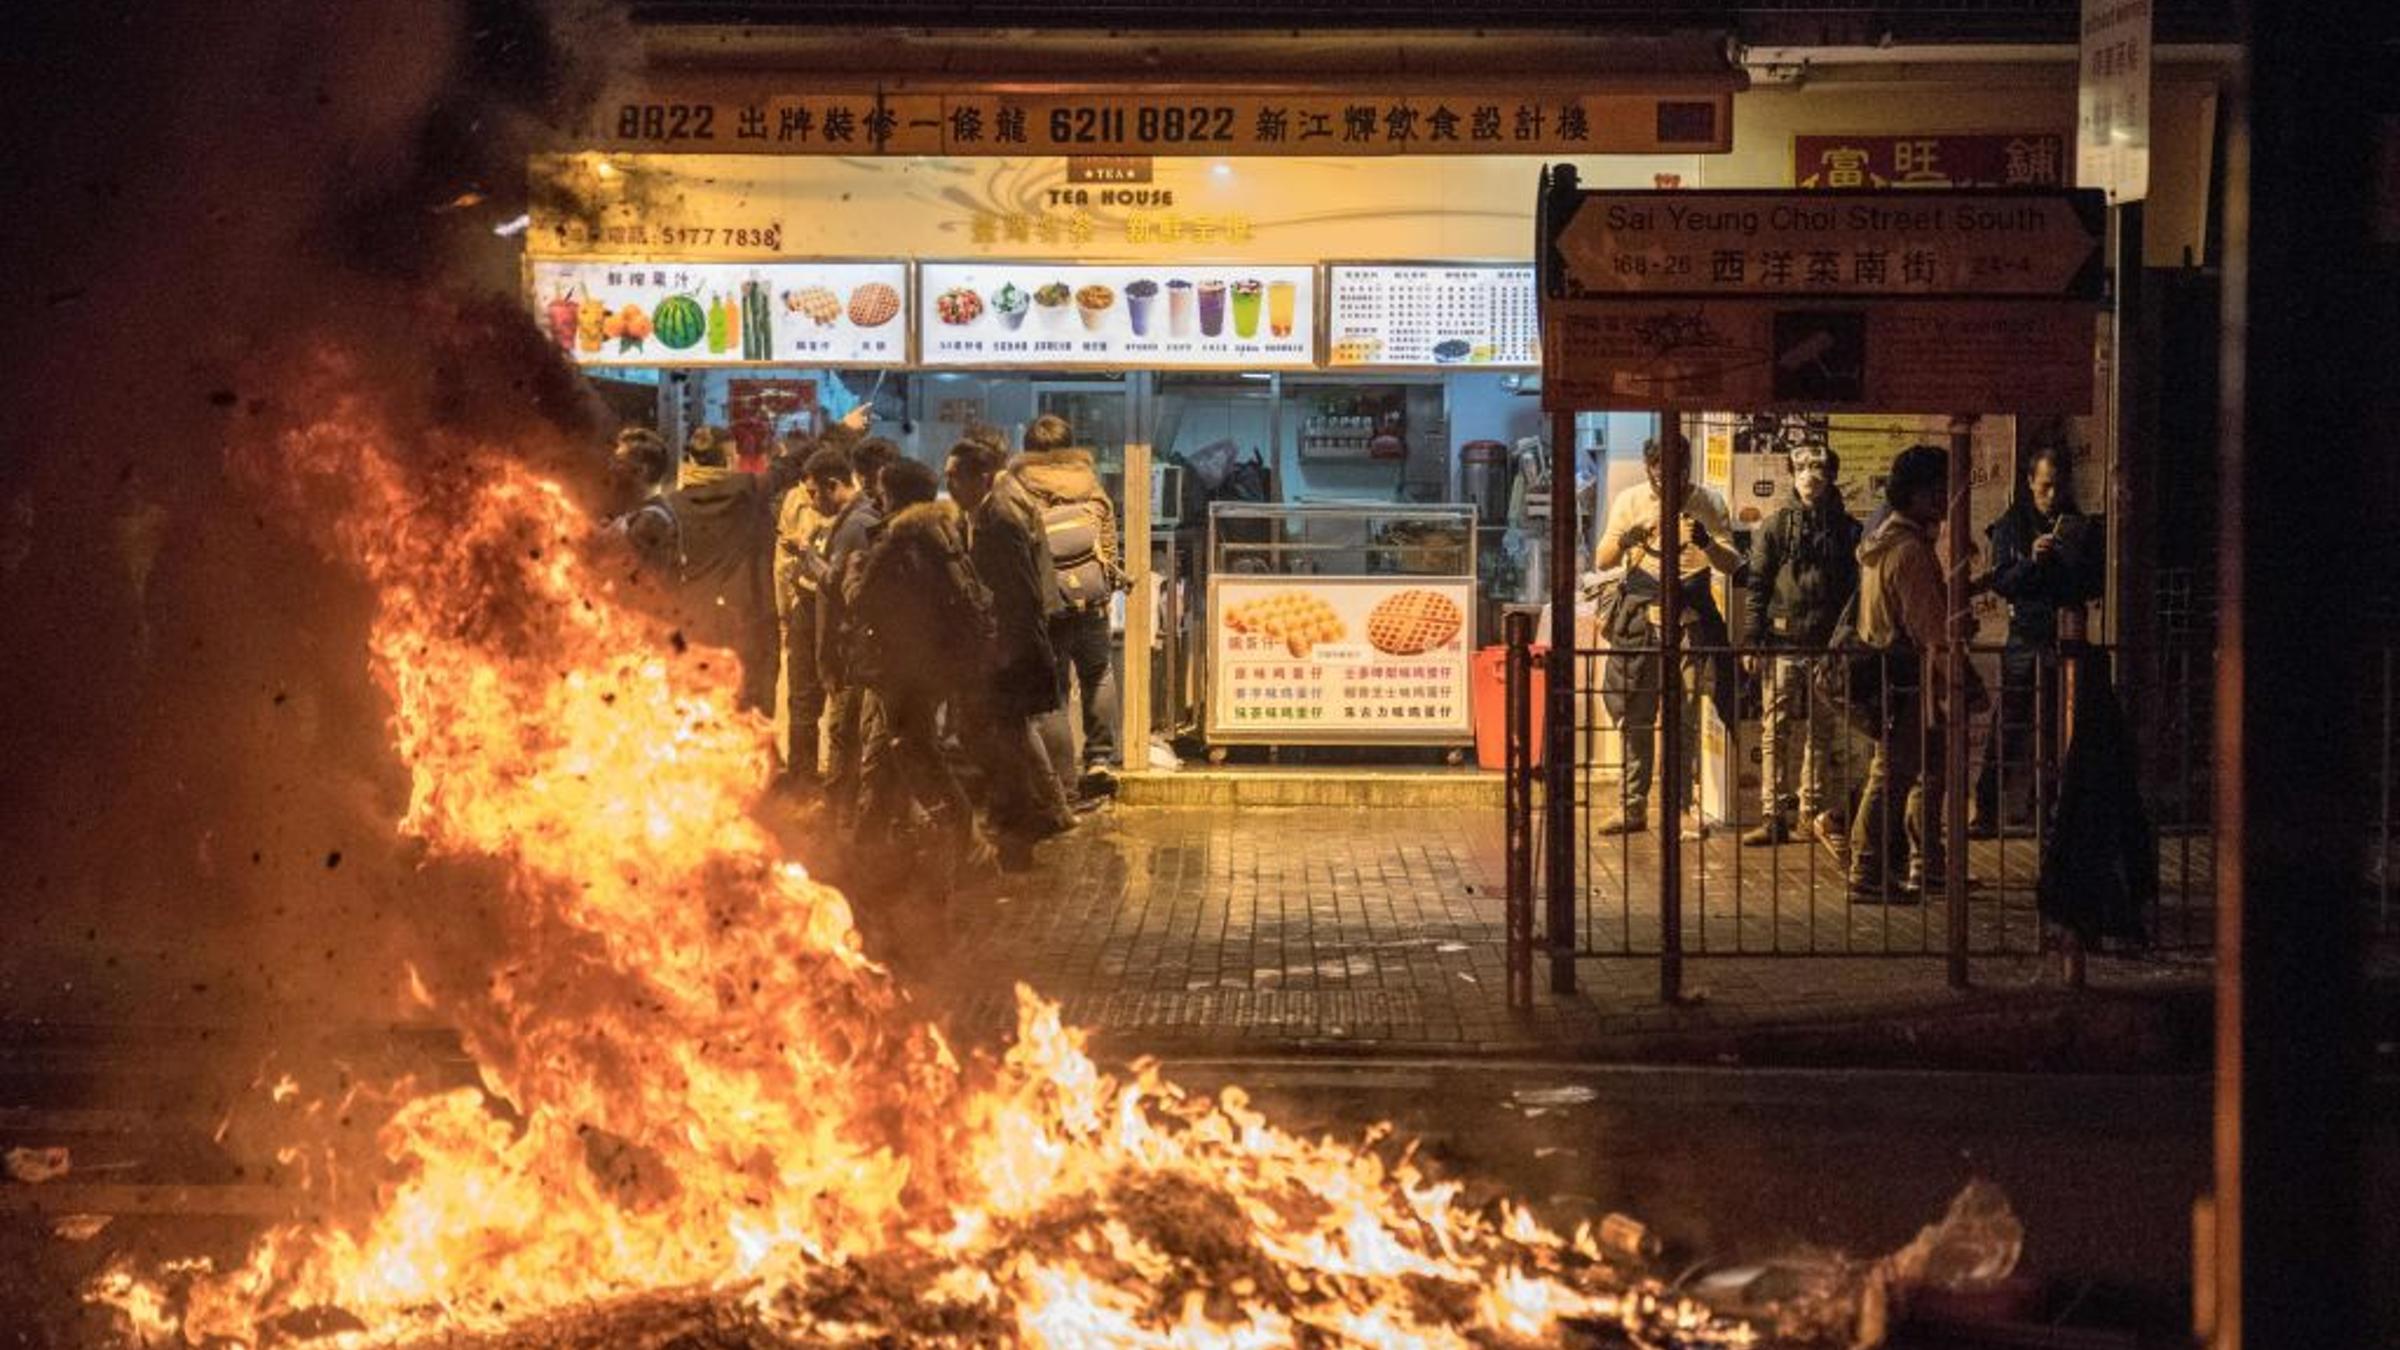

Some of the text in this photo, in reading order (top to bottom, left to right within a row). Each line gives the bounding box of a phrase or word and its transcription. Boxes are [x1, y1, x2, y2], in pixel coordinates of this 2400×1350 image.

[737, 104, 1028, 143] 出牌裝修一條龍
[1050, 107, 1123, 143] 6211
[1138, 107, 1235, 142] 8822
[1256, 104, 1590, 143] 新江輝飲食設計樓
[1050, 189, 1173, 206] TEA HOUSE
[1607, 205, 2046, 235] Sai Yeung Choi Street South
[662, 227, 715, 245] 5177
[722, 227, 776, 246] 7838
[1711, 248, 1937, 284] 西洋菜南街
